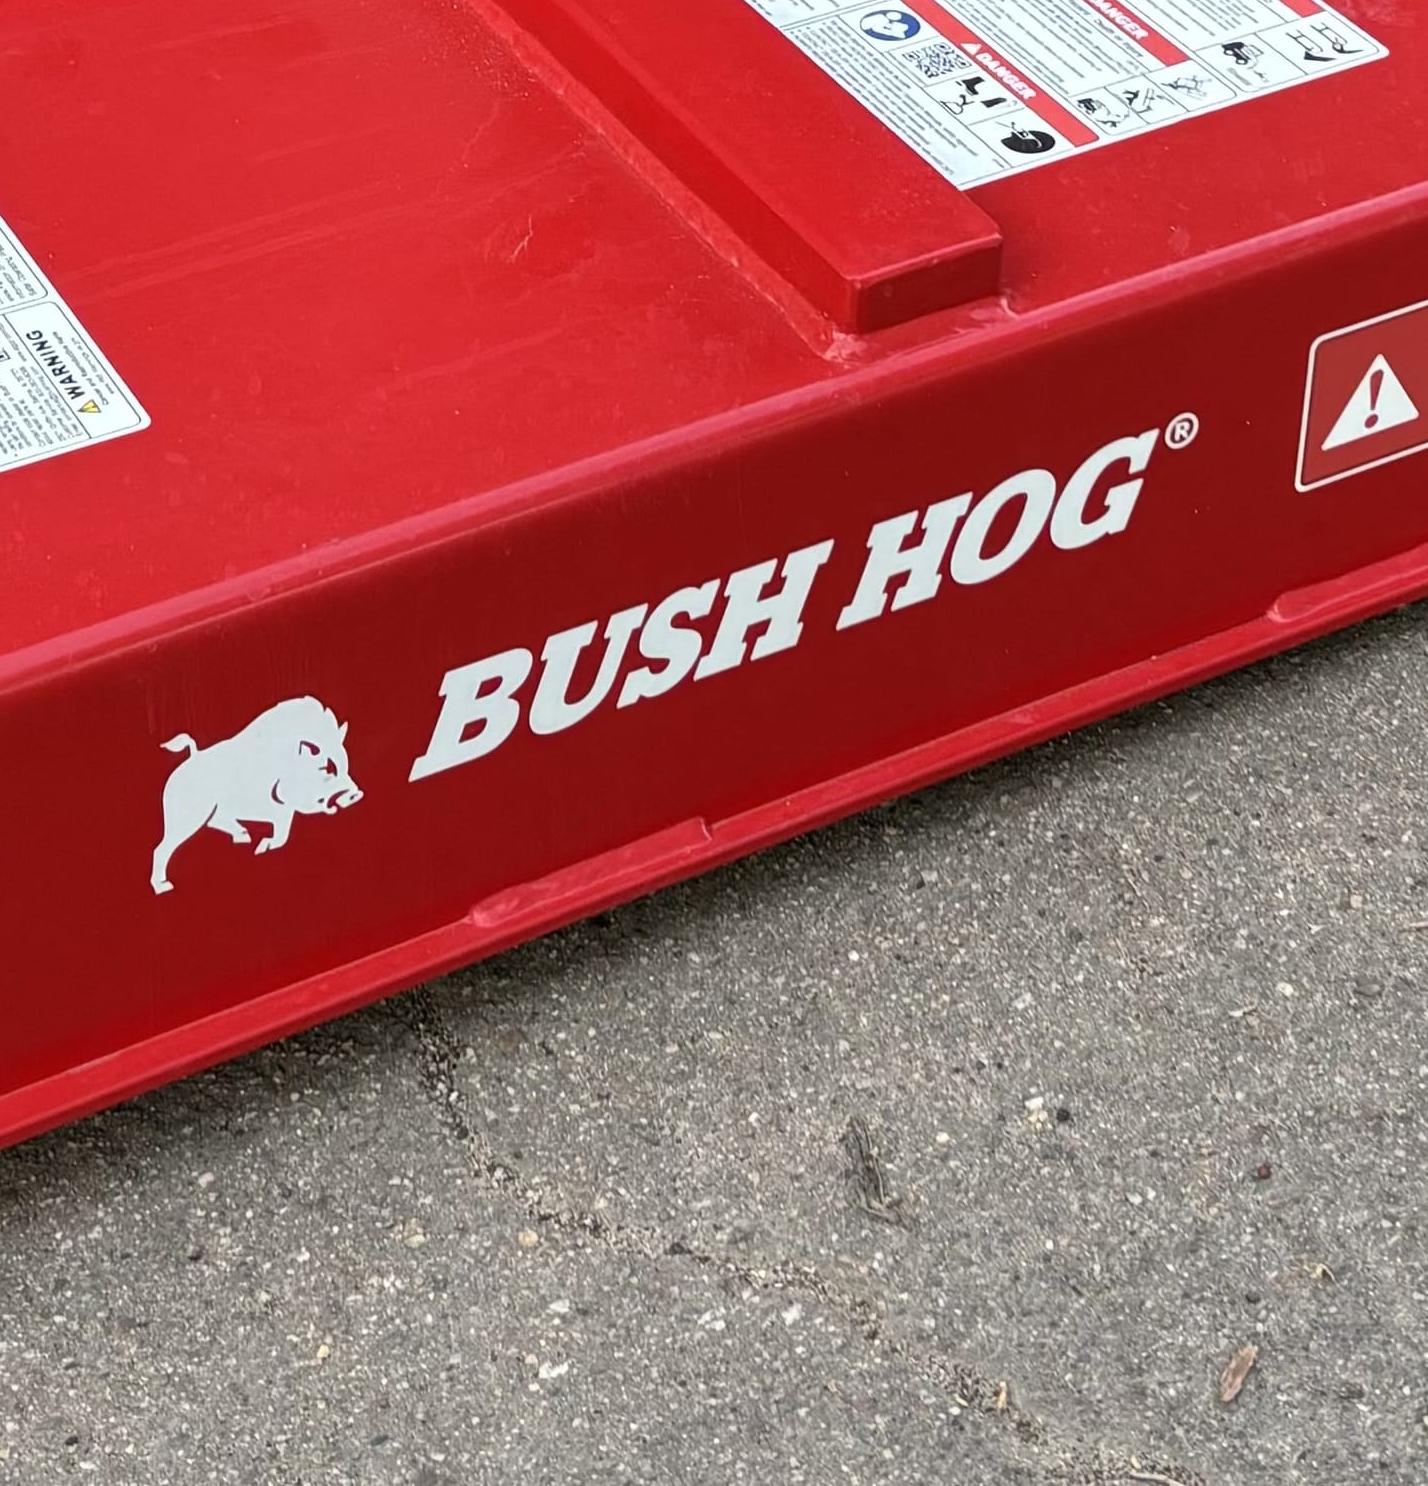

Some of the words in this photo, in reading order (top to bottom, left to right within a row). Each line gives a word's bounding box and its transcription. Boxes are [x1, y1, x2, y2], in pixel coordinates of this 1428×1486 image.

[972, 51, 1040, 100] DANGER
[23, 328, 87, 400] WARNING
[407, 538, 835, 783] BUSH
